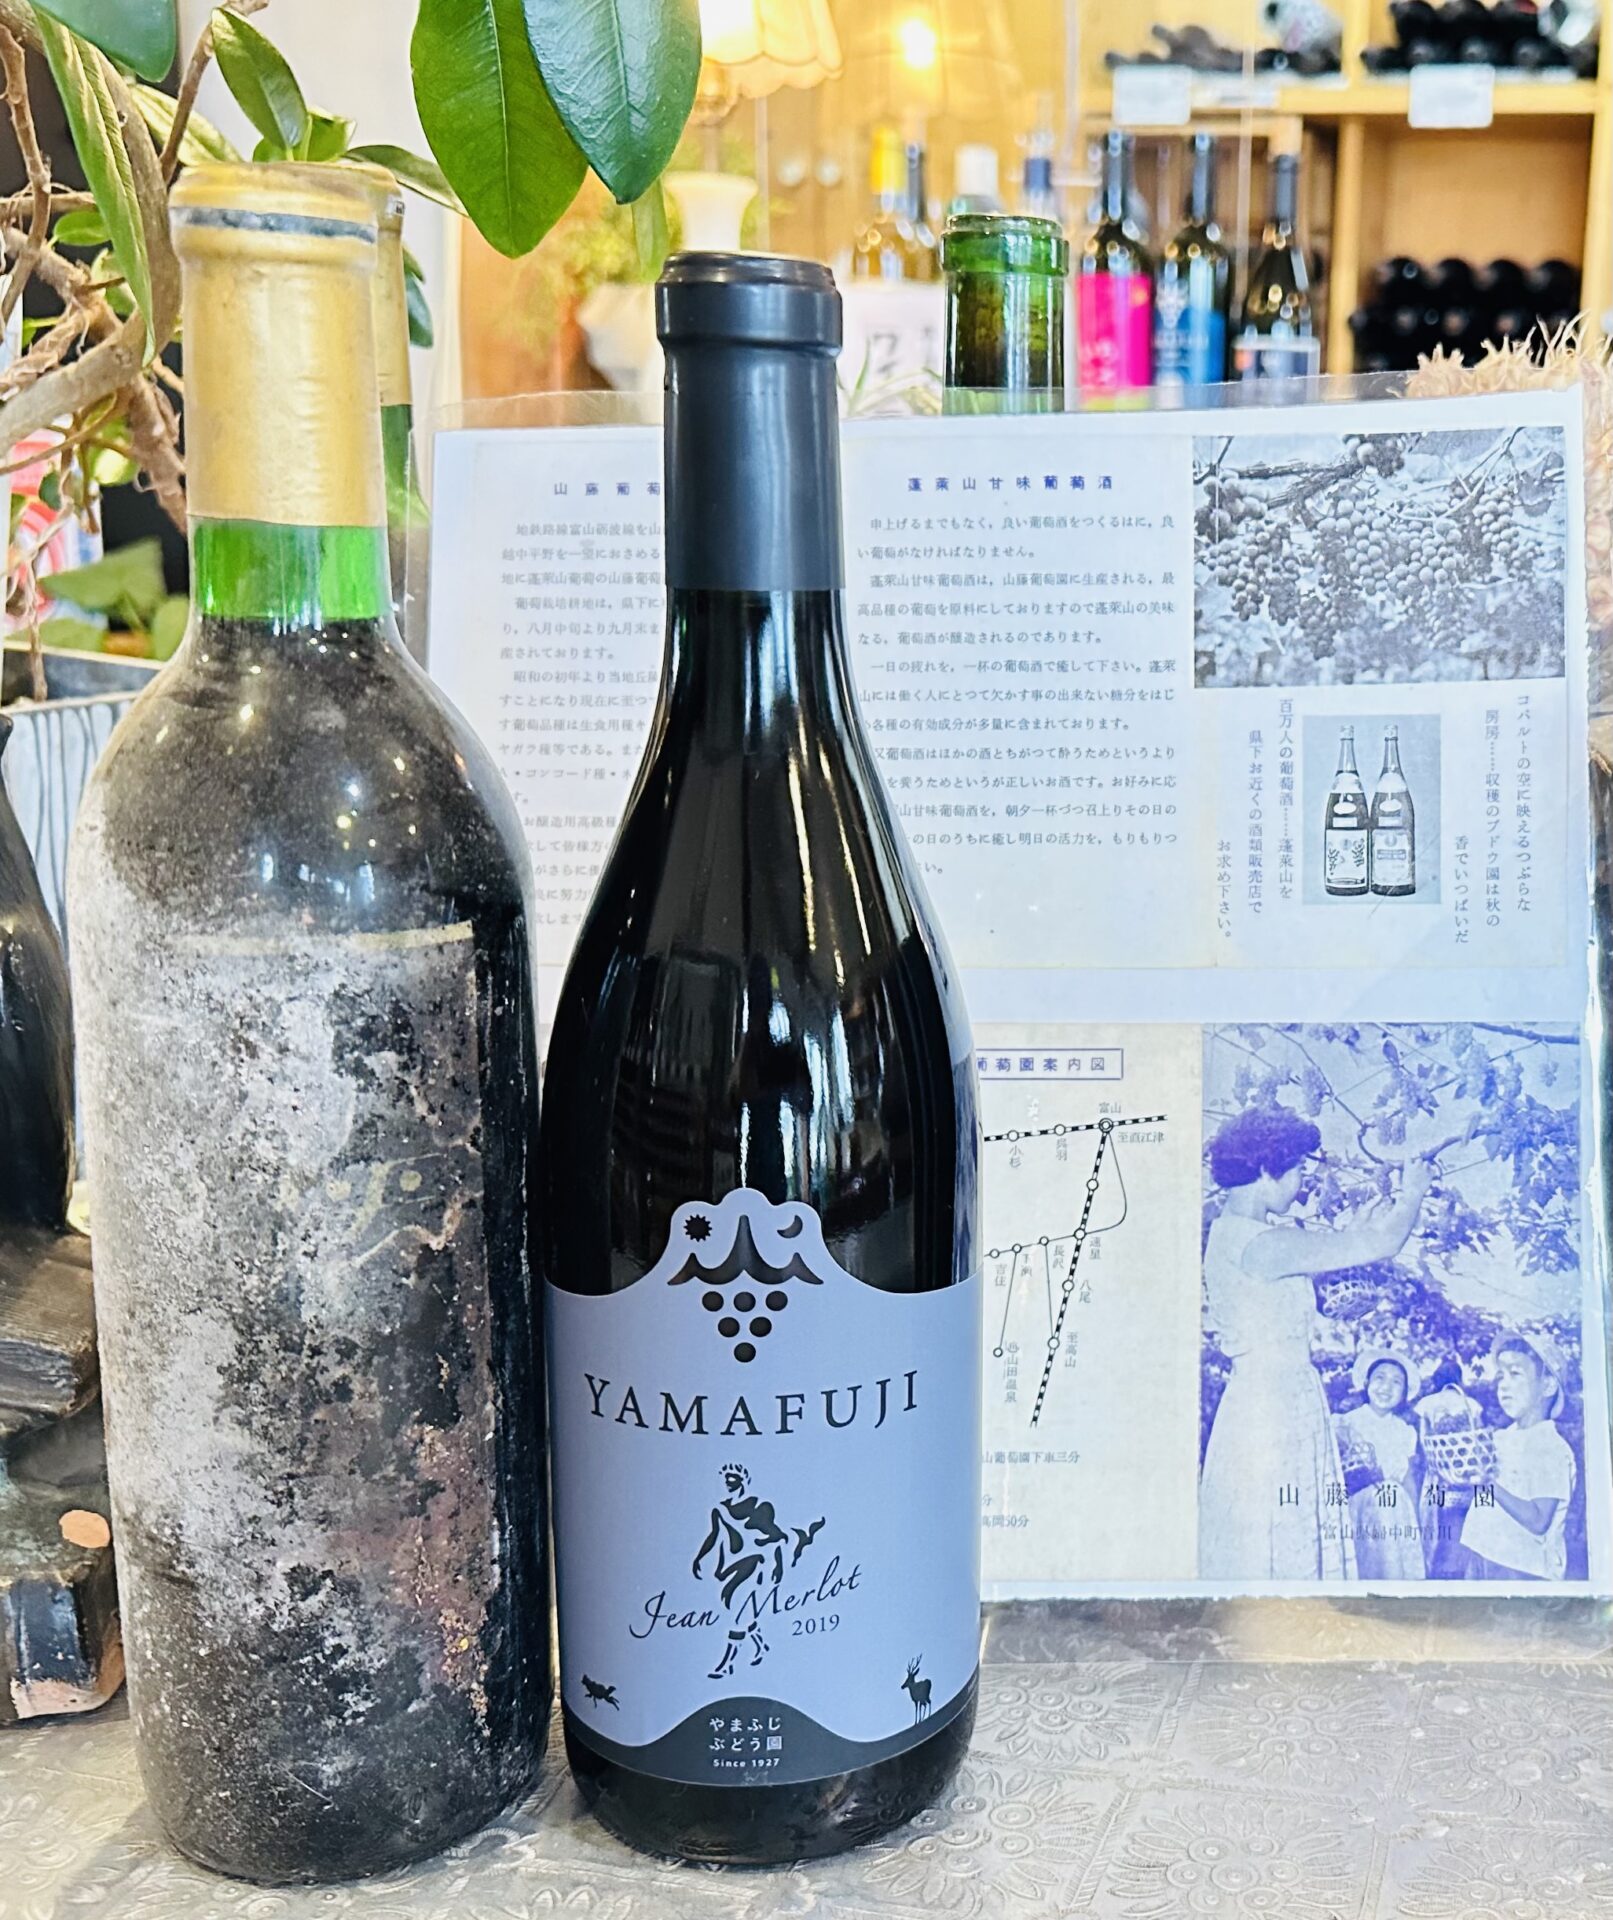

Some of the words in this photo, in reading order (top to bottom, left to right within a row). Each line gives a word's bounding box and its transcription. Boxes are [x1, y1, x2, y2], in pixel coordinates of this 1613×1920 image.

[865, 717, 1130, 731] 各種の有効成分が多量に含まれております。
[1099, 1102, 1122, 1114] 富山
[1009, 1145, 1023, 1169] 小杉
[1079, 1280, 1092, 1303] 八尾
[583, 1370, 918, 1436] YAMAFUJI
[1278, 1483, 1495, 1508] 山藤葡萄園
[628, 1590, 720, 1639] Jean
[735, 1555, 862, 1624] Merlot
[792, 1614, 840, 1636] 2019
[709, 1717, 781, 1732] やまふじ
[713, 1758, 746, 1767] Since
[752, 1758, 780, 1767] 1927
